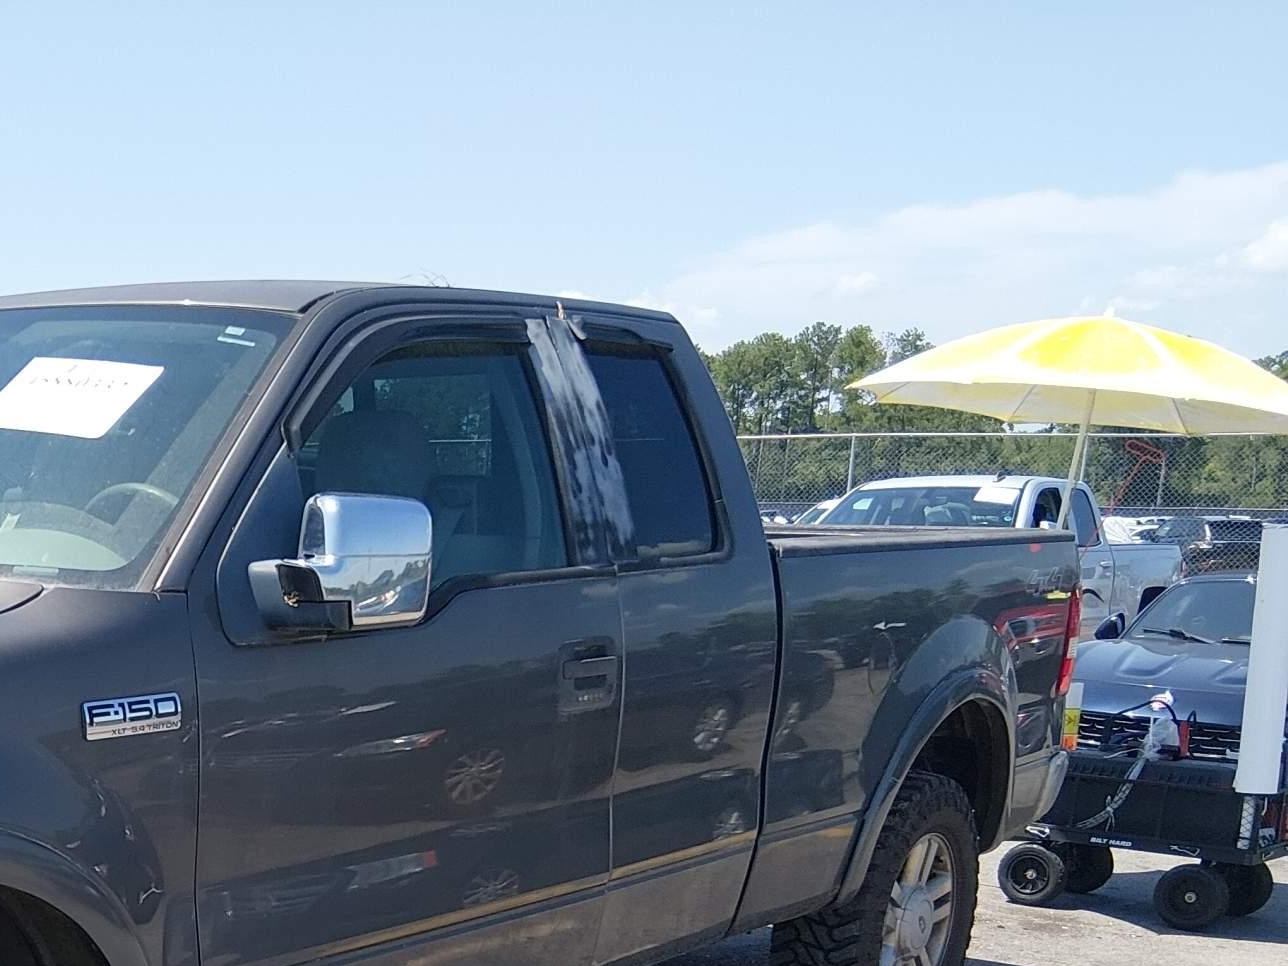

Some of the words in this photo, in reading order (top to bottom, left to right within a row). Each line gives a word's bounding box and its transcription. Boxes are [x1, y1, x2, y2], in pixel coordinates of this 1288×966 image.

[87, 696, 179, 726] F-150
[111, 727, 127, 736] XLT
[146, 721, 179, 732] TRITON
[1109, 839, 1132, 847] HARD
